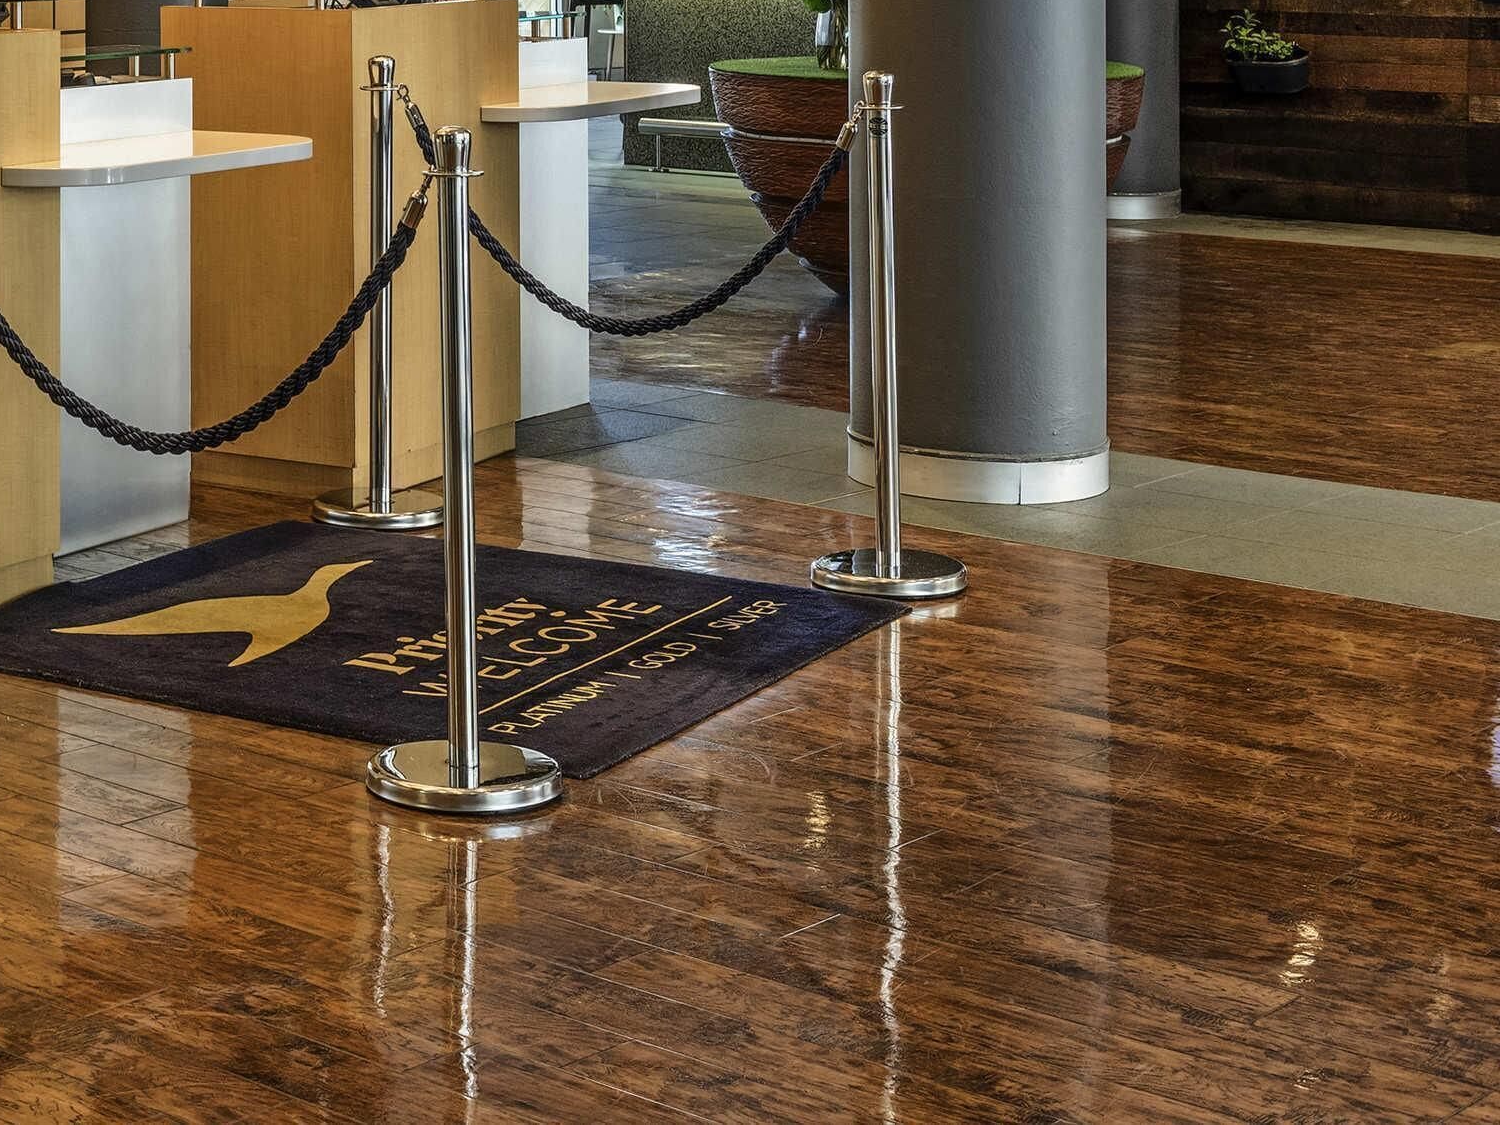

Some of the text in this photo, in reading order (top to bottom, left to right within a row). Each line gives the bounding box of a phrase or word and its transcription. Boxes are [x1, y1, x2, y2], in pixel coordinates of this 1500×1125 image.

[487, 680, 617, 736] PLATINUM
[628, 641, 697, 670] GOLD
[707, 599, 788, 632] SILVER
